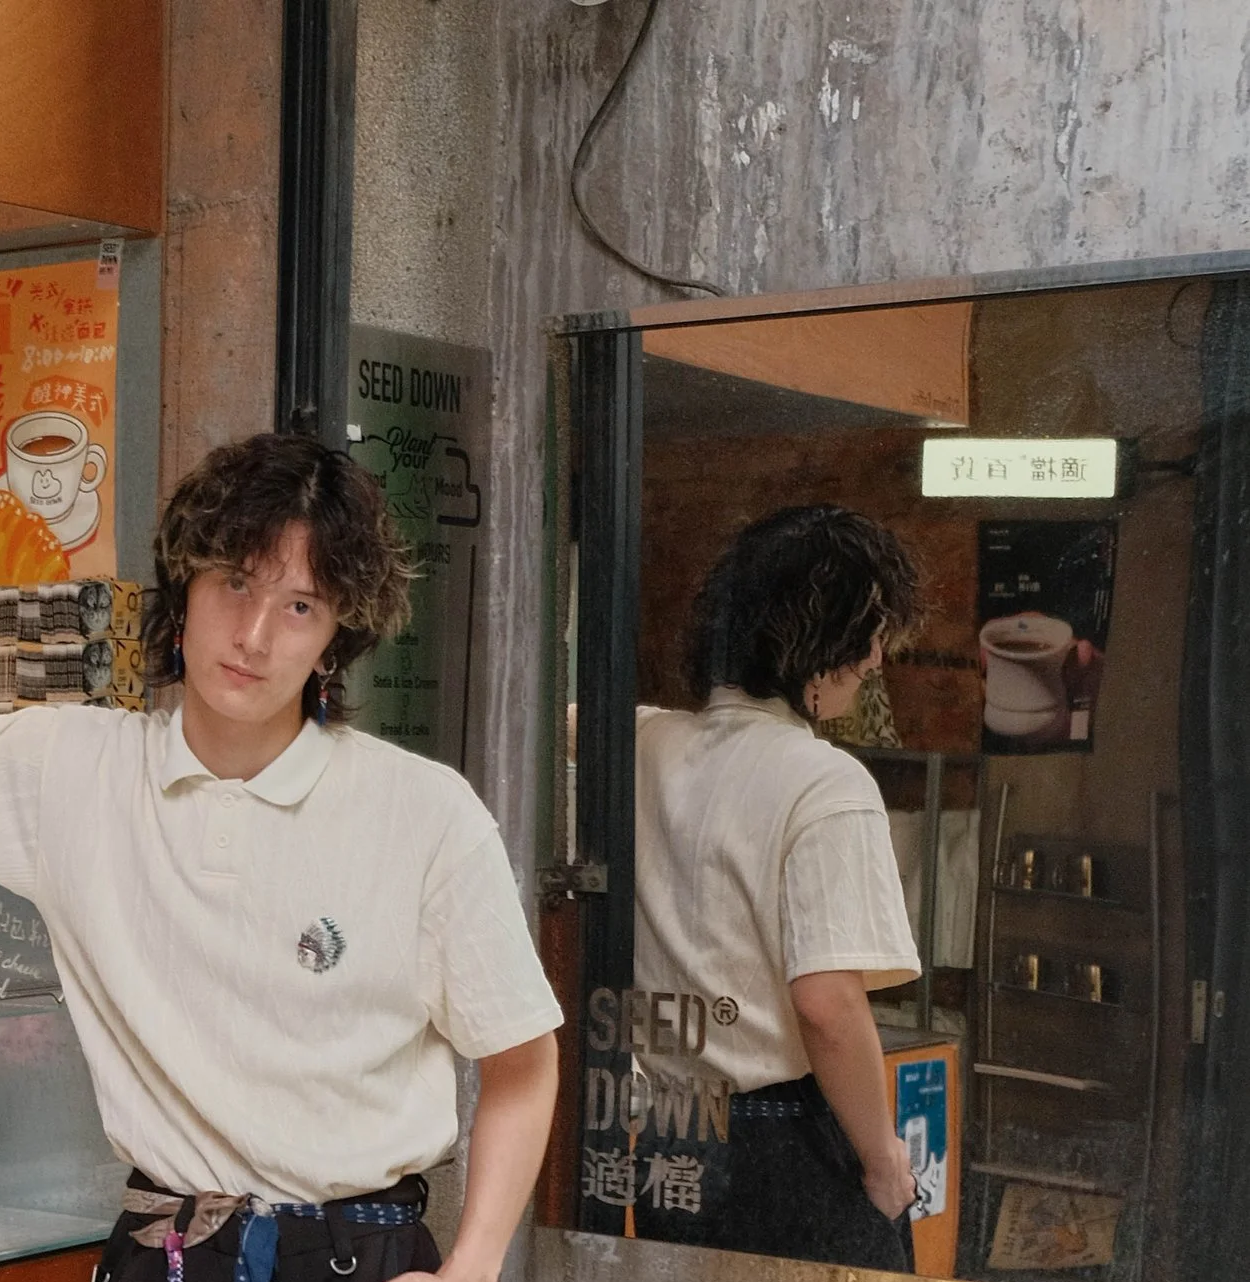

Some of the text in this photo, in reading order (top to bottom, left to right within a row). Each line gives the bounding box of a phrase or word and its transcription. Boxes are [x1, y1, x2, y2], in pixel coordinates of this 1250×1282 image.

[31, 383, 104, 424] 醒神美式
[358, 359, 461, 413] SEED DOWN
[387, 426, 438, 457] Plant
[391, 451, 431, 472] your
[585, 1066, 731, 1145] DOWN
